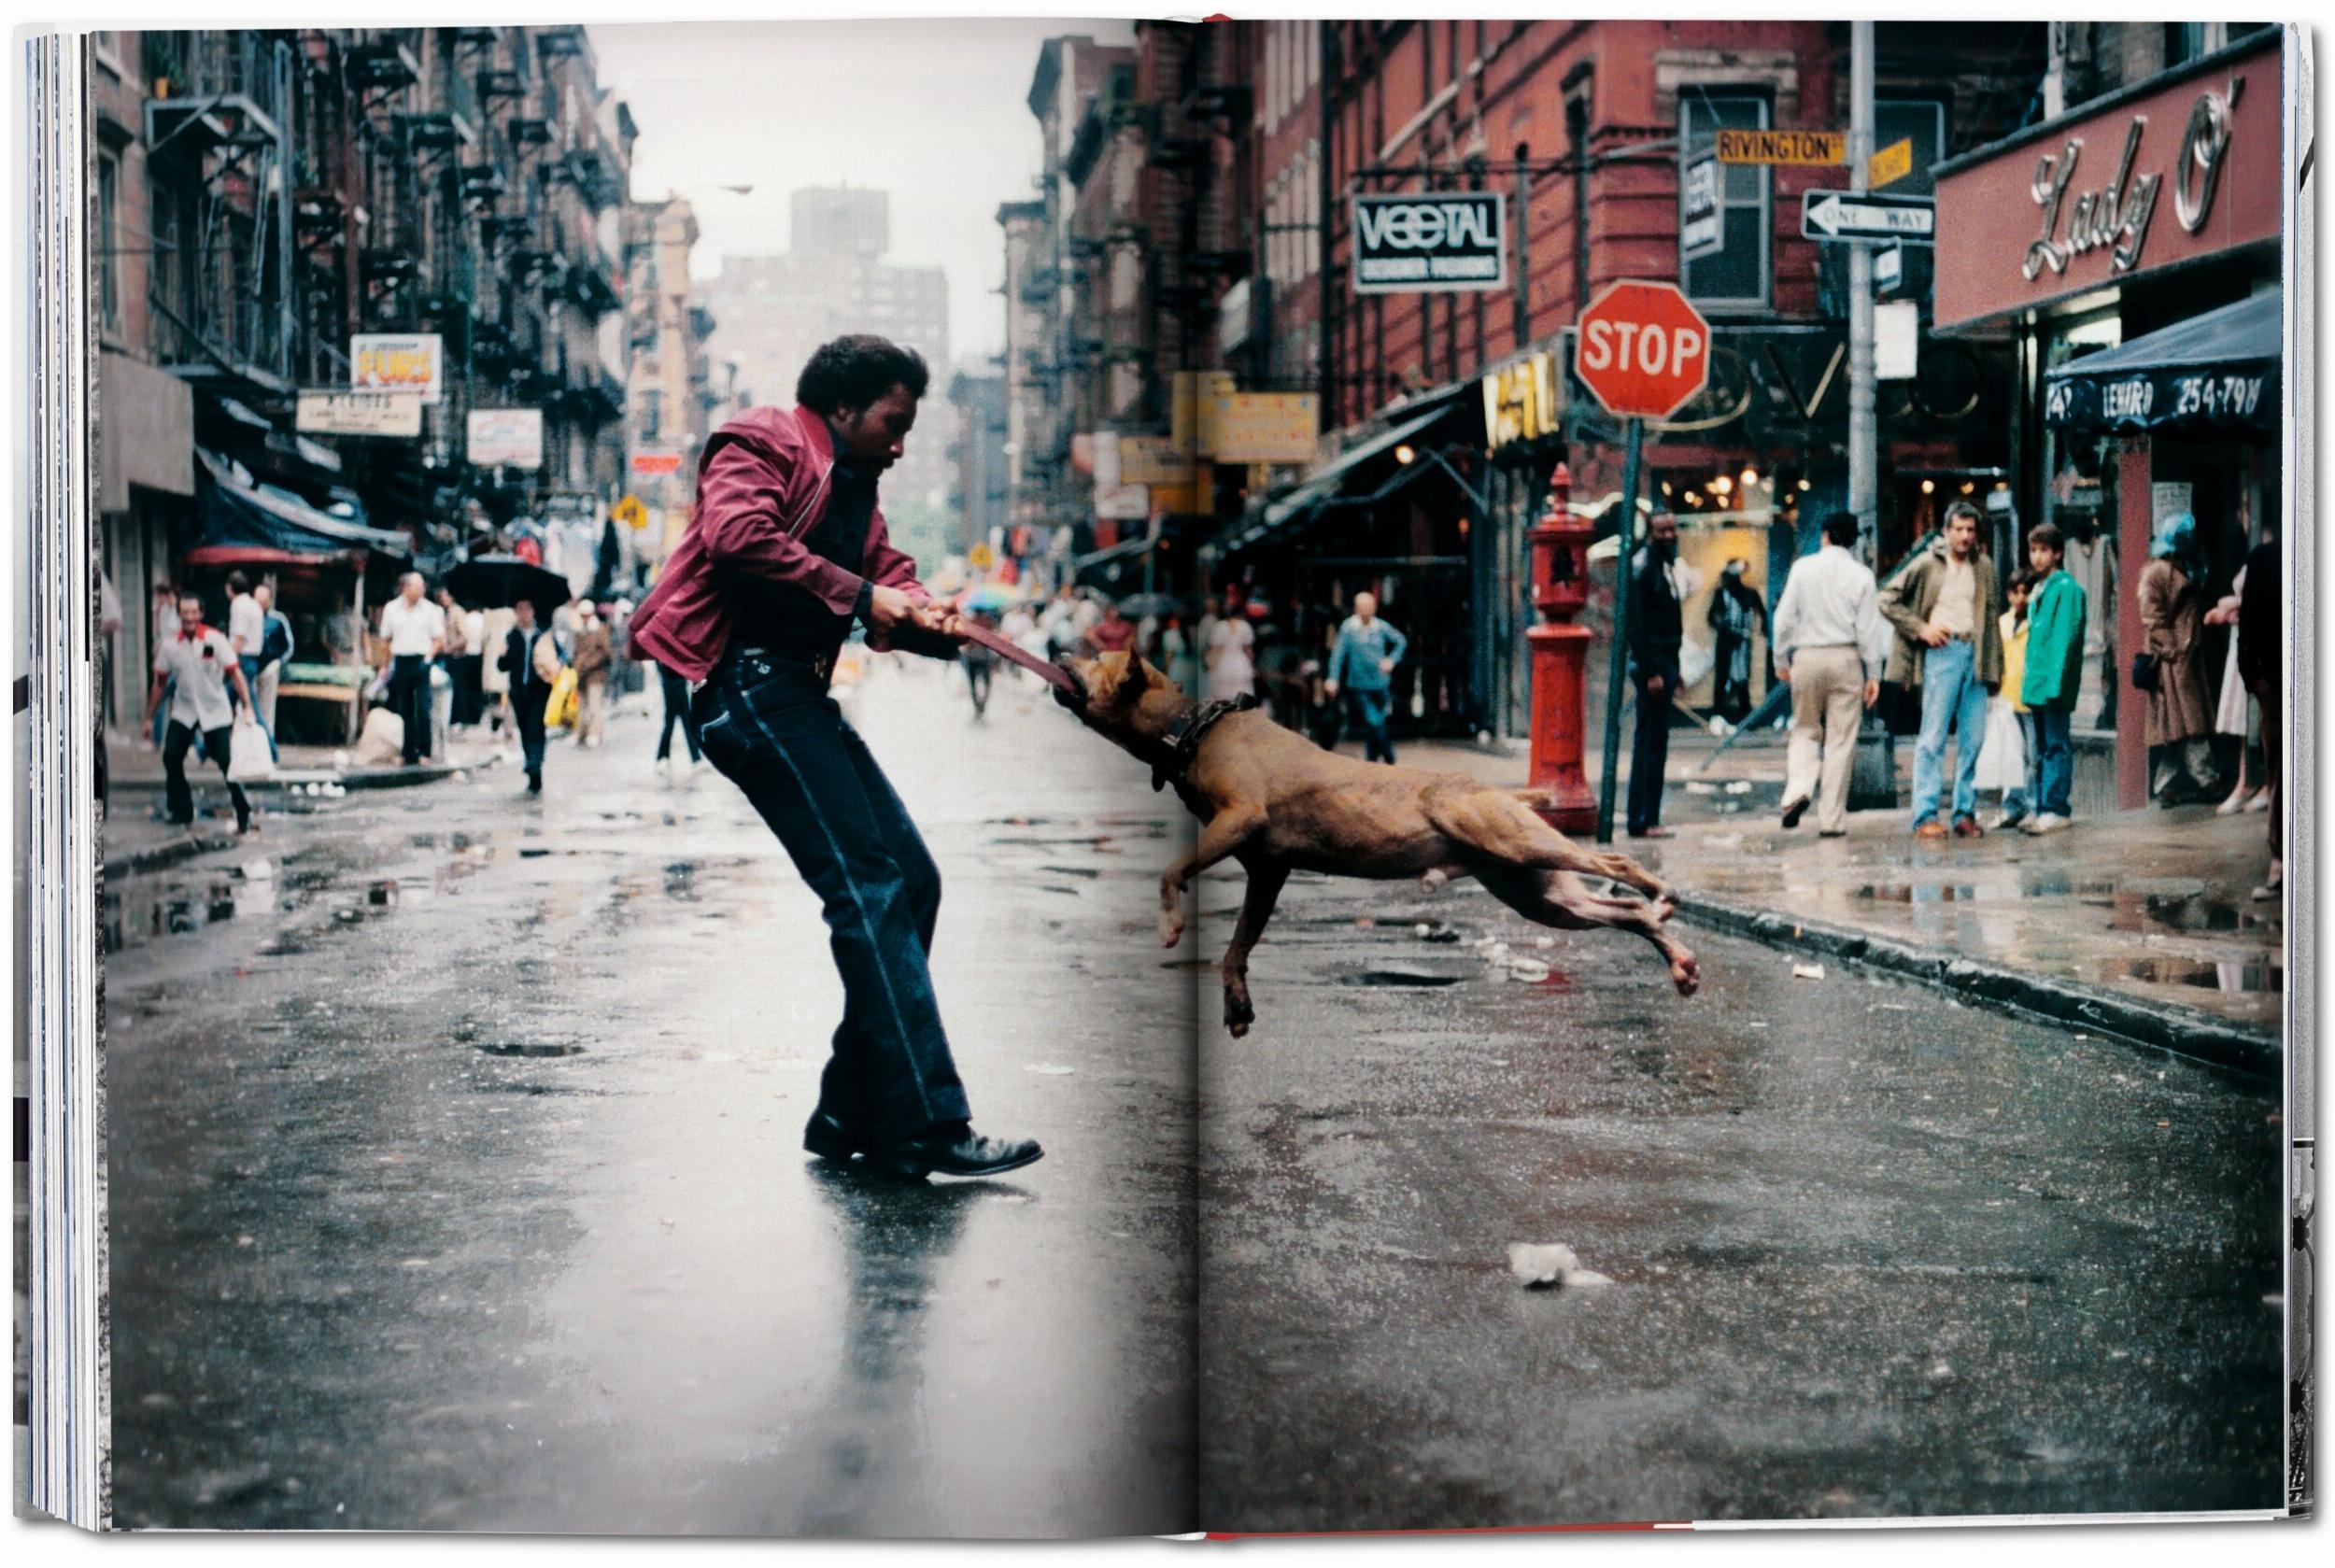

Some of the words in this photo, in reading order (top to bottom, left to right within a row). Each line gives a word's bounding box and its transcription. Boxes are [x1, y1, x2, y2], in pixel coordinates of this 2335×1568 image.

[1719, 131, 1831, 160] RIVINGTON
[2022, 115, 2162, 280] Lady
[1885, 208, 1923, 228] WAY
[1584, 318, 1702, 377] STOP
[358, 349, 432, 385] FURS
